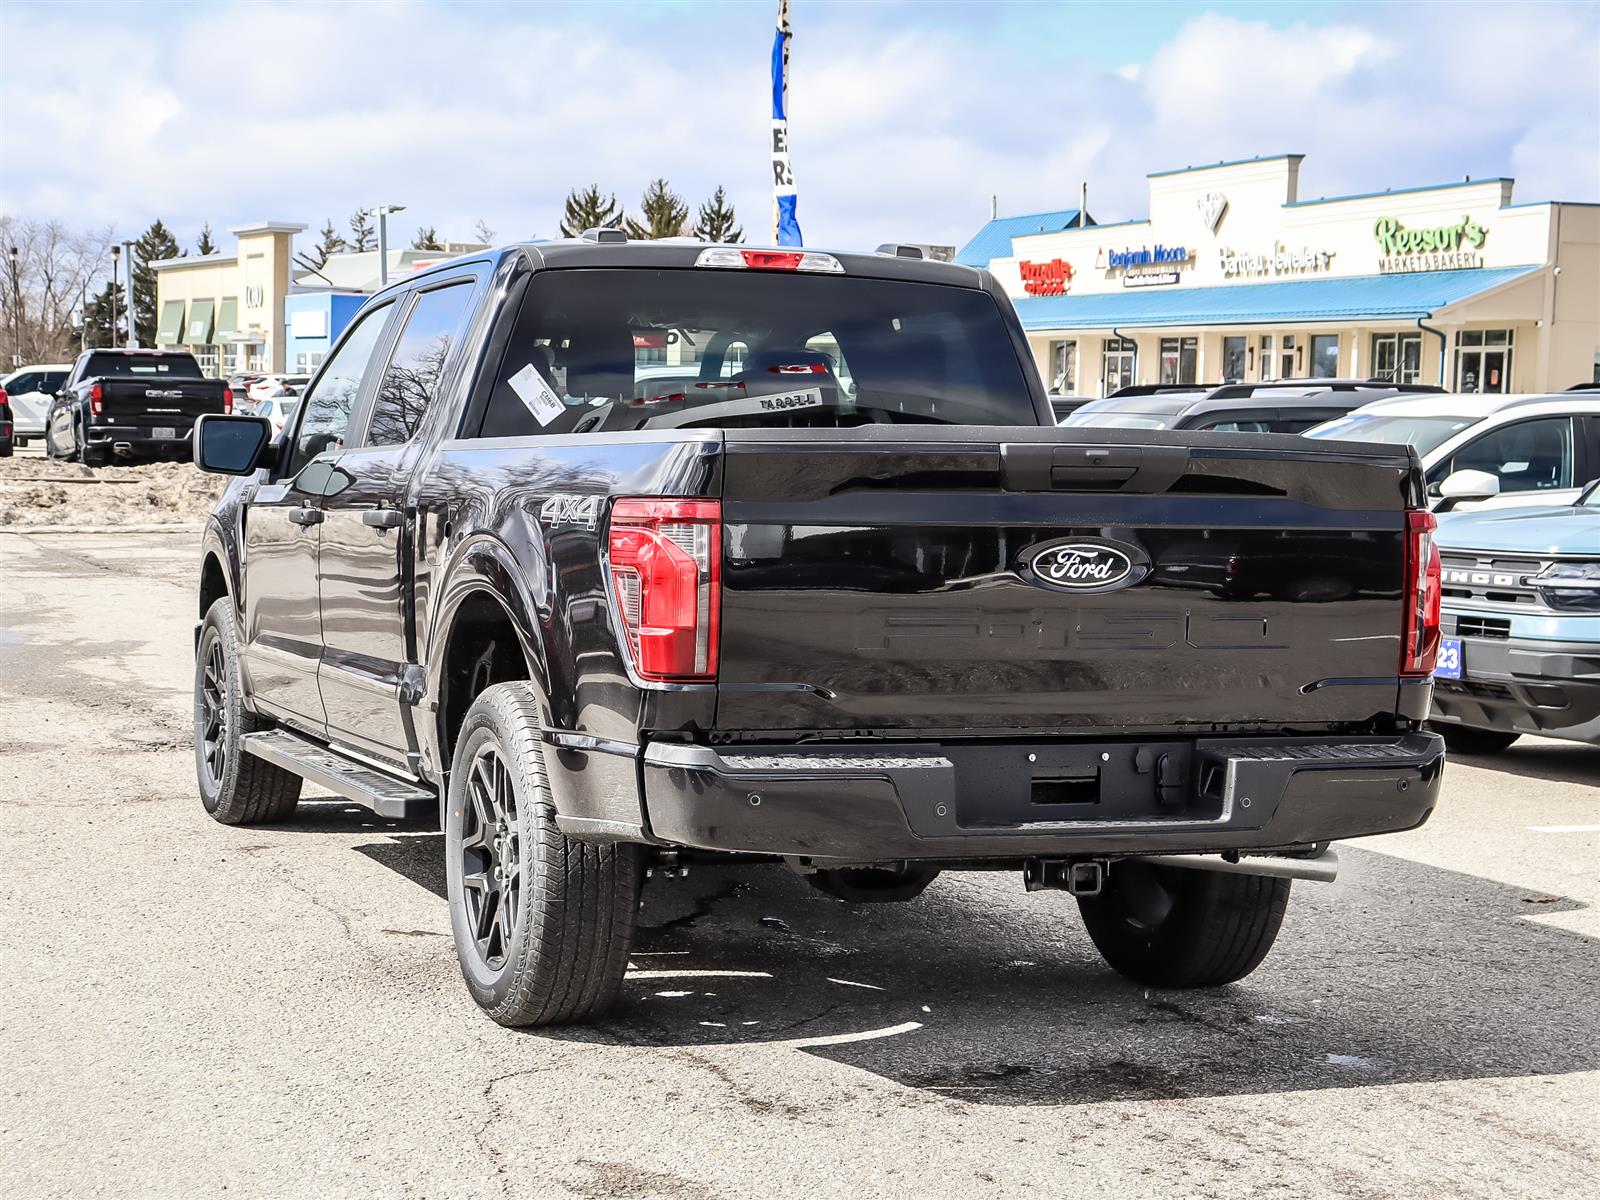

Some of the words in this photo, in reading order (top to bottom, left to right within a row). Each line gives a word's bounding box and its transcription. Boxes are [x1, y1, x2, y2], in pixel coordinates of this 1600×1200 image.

[1374, 215, 1485, 253] Reesor's
[1108, 245, 1151, 269] Benjamin
[1154, 244, 1186, 262] Moore
[1378, 256, 1421, 273] MARKET
[1433, 252, 1476, 270] BAKERY
[1050, 549, 1114, 579] Ford
[1437, 646, 1459, 670] 23
